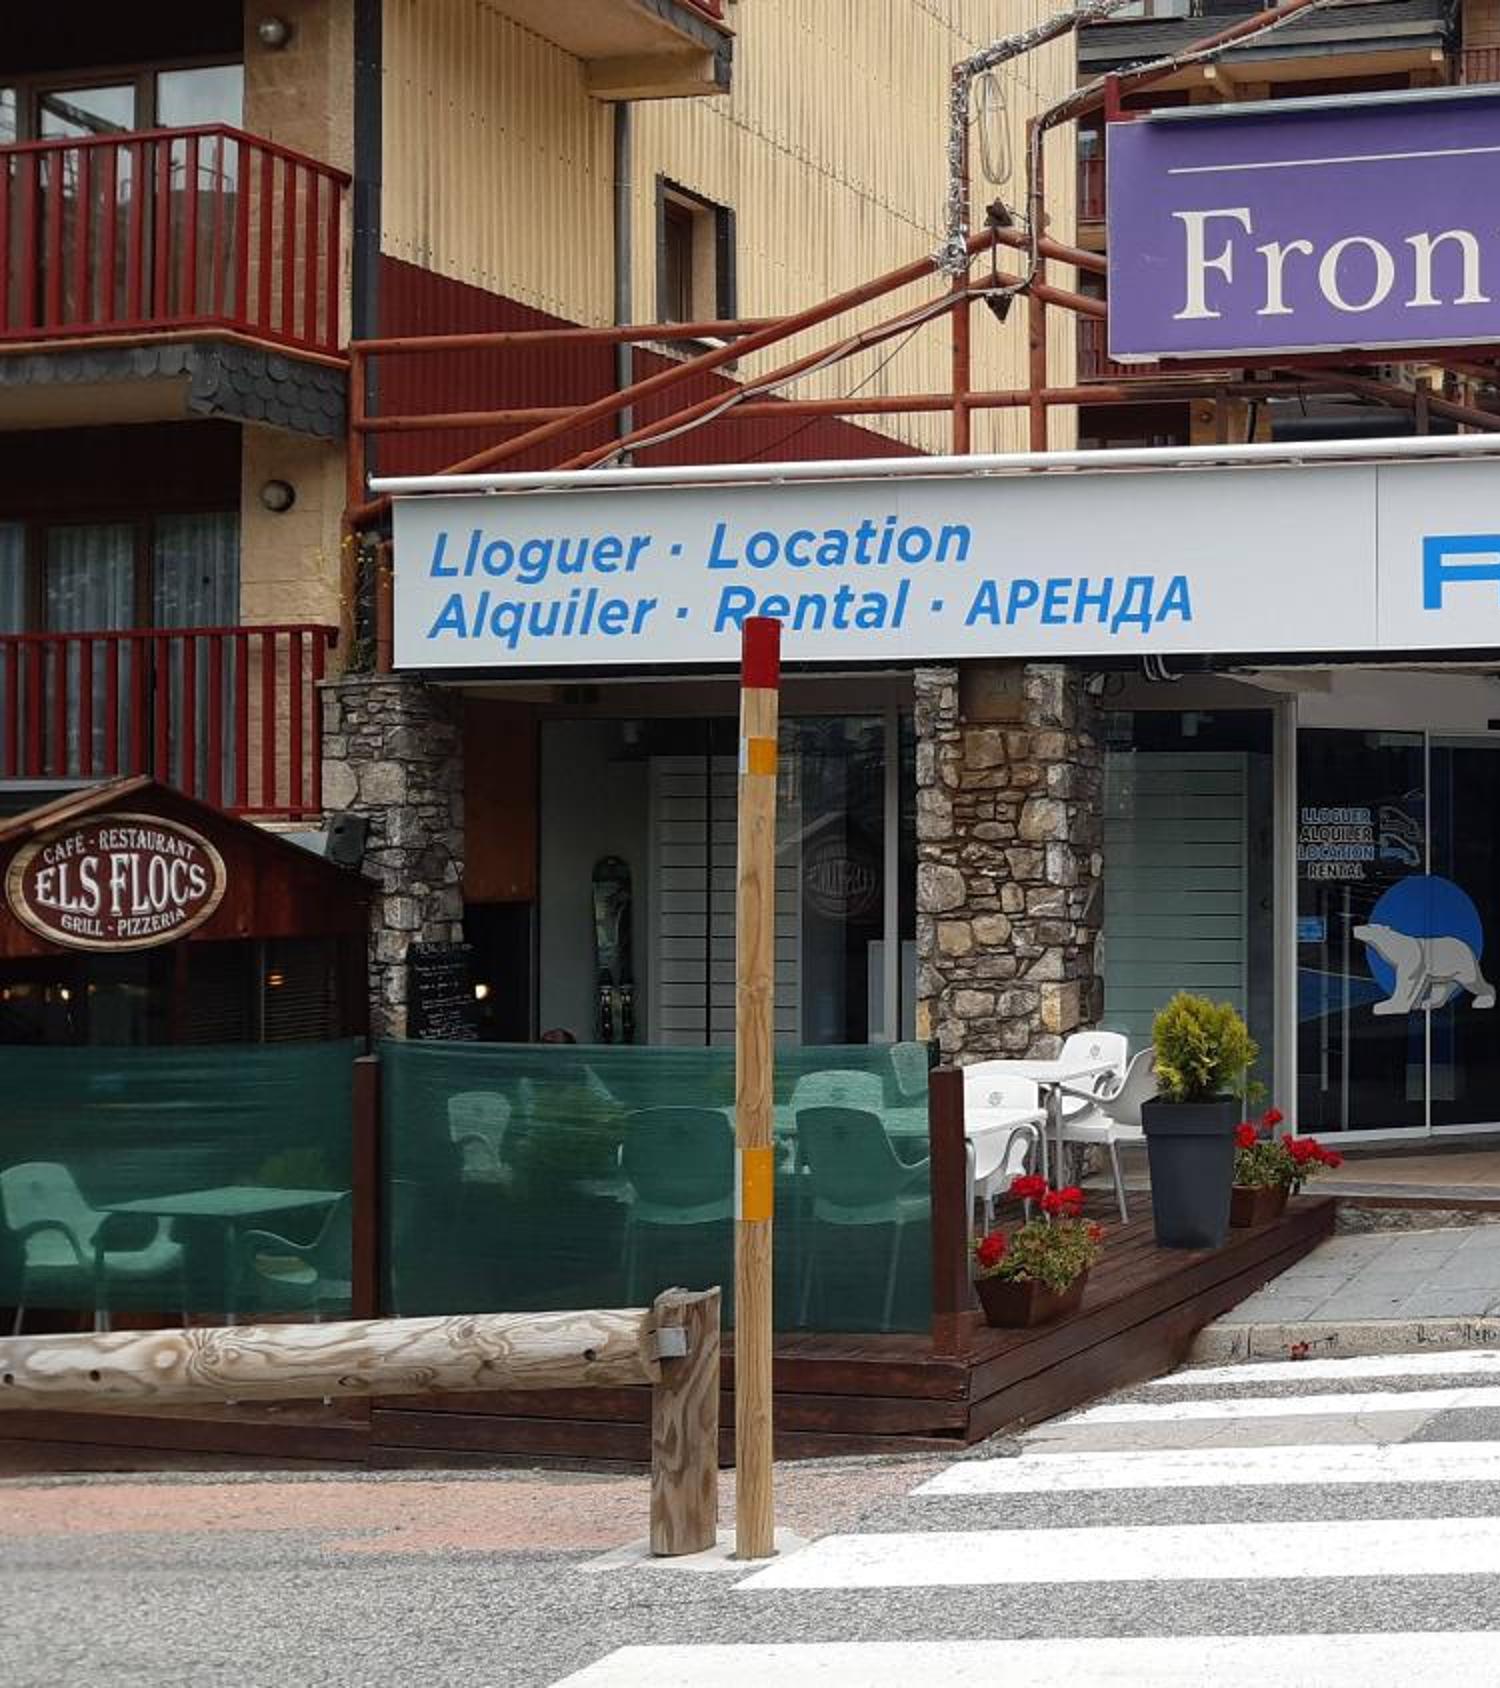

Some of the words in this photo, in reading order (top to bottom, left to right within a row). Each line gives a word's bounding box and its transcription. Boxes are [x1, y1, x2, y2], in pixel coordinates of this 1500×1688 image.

[429, 531, 651, 584] Lloguer
[706, 515, 973, 570] Location
[427, 589, 657, 650] Alquiler
[713, 577, 911, 633] Rental
[965, 575, 1194, 634] АРЕНДА
[99, 828, 197, 860] RESTAURANT
[1299, 825, 1374, 842] ALQUILER
[35, 855, 100, 917] ELS
[108, 852, 208, 917] FLOCS
[60, 914, 104, 936] GRILL
[116, 908, 187, 937] PIZZERIA
